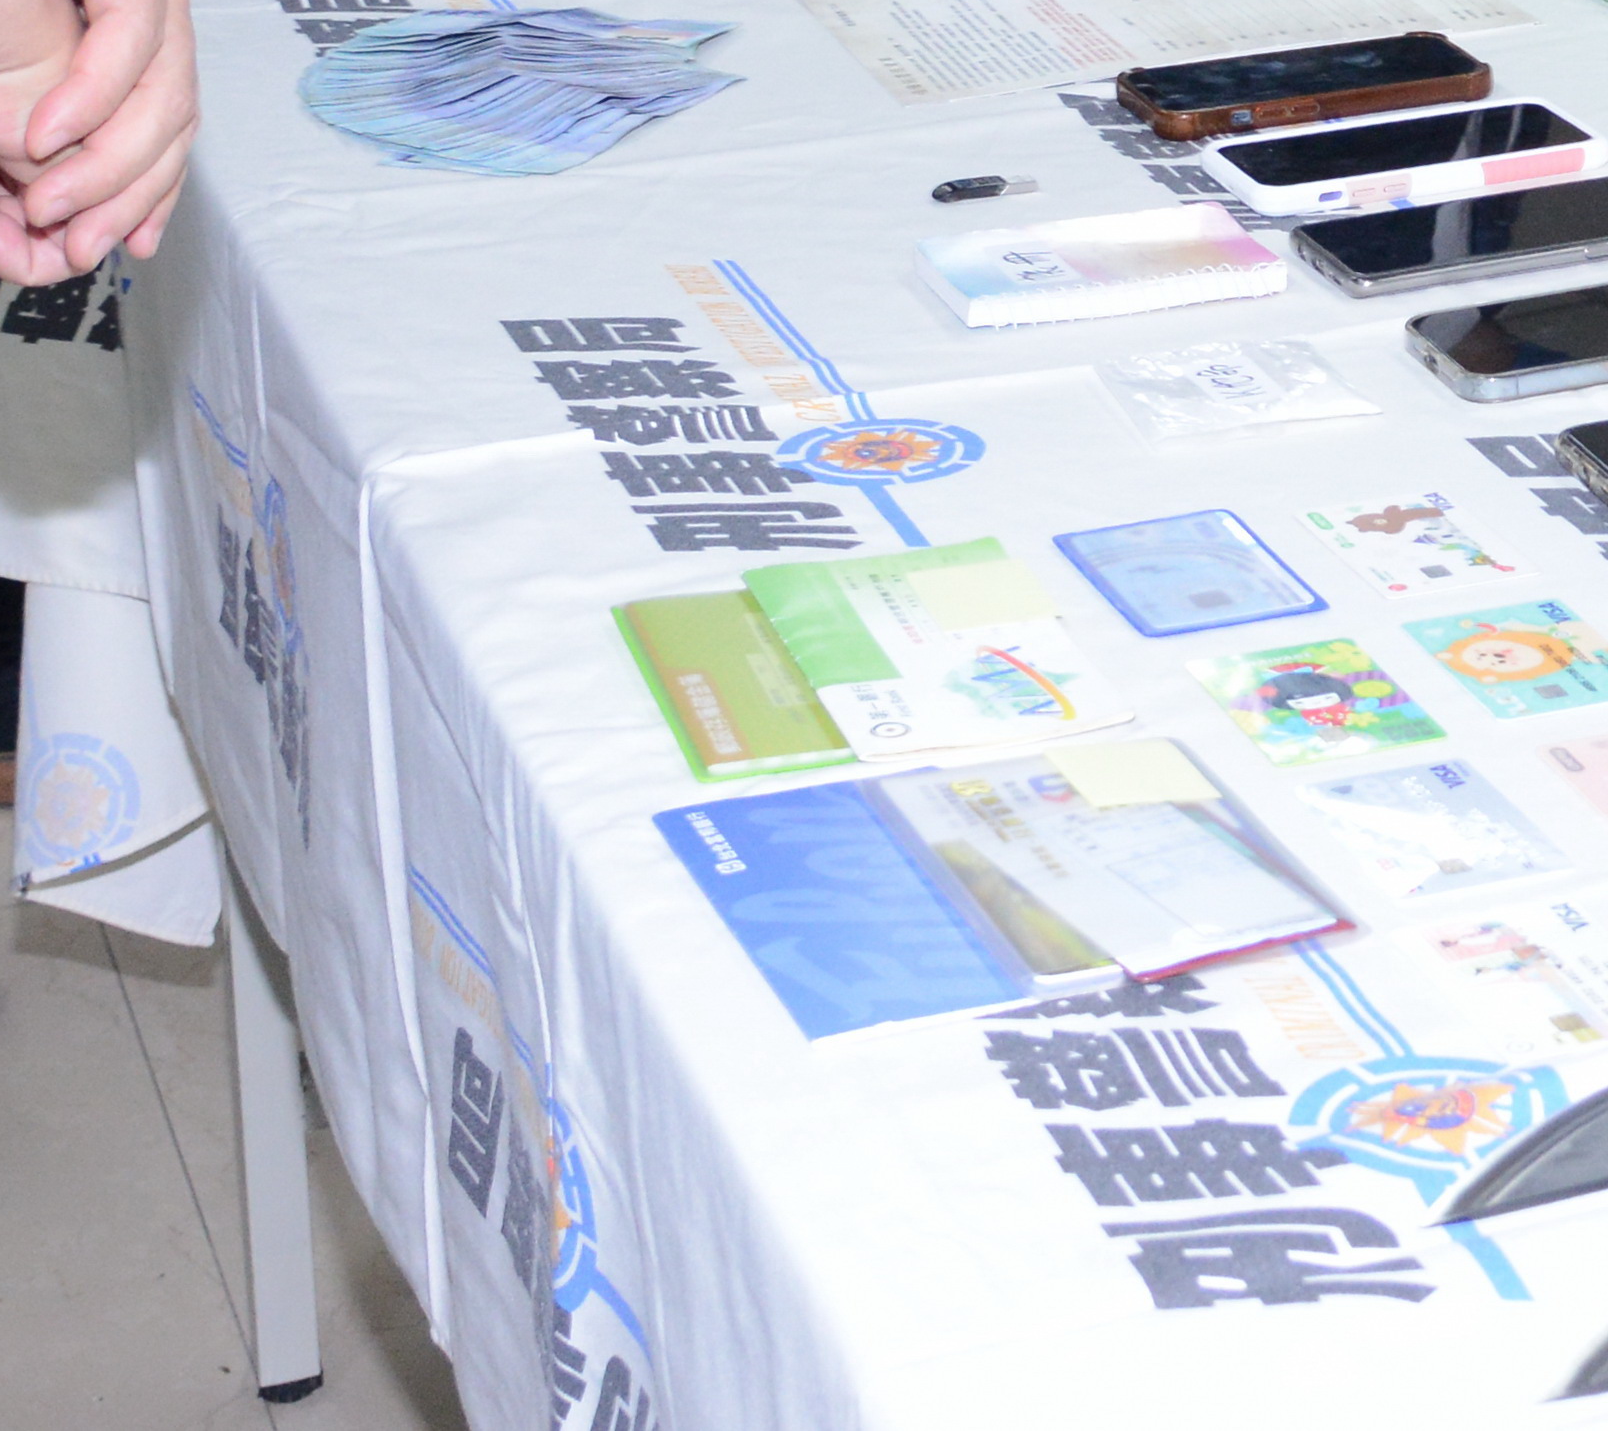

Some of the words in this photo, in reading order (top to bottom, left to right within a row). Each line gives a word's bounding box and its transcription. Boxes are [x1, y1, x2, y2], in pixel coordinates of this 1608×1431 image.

[499, 317, 865, 551] 刑事警察局
[1538, 599, 1572, 624] VISA
[1430, 761, 1467, 789] VISA
[1551, 901, 1590, 932] VISA
